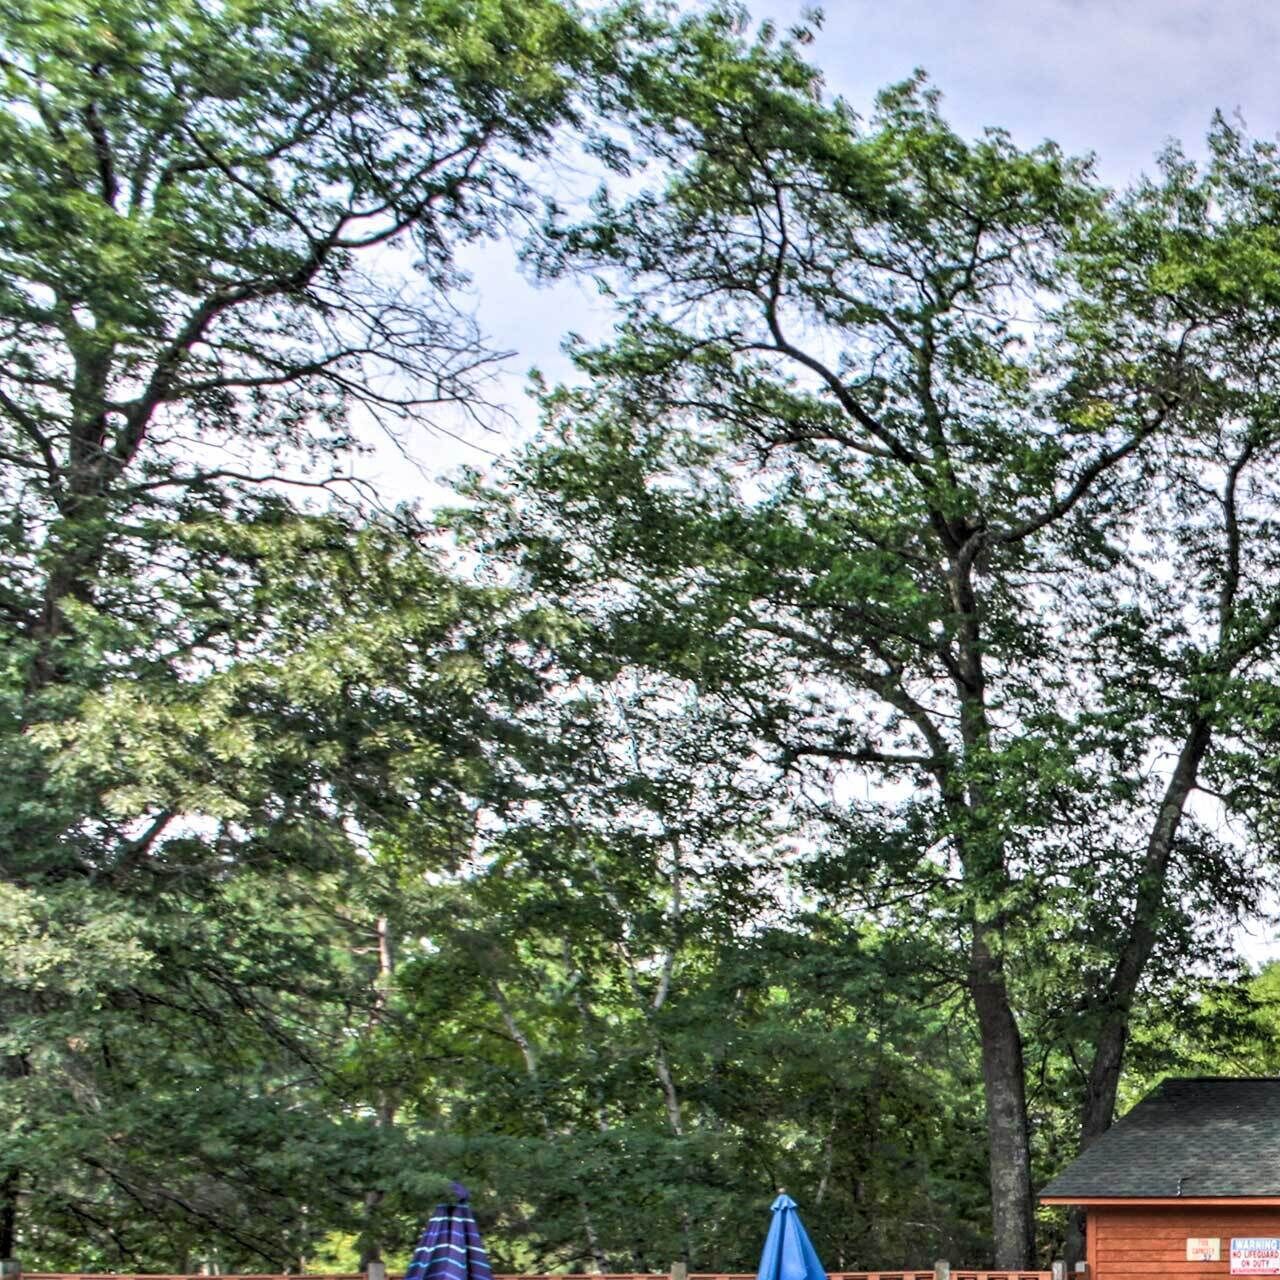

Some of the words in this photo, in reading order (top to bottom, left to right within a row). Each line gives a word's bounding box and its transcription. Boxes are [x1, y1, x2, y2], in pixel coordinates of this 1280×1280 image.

[1235, 1239, 1277, 1250] WARNING
[1233, 1250, 1241, 1258] NO
[1244, 1250, 1279, 1258] LIFEGUARD
